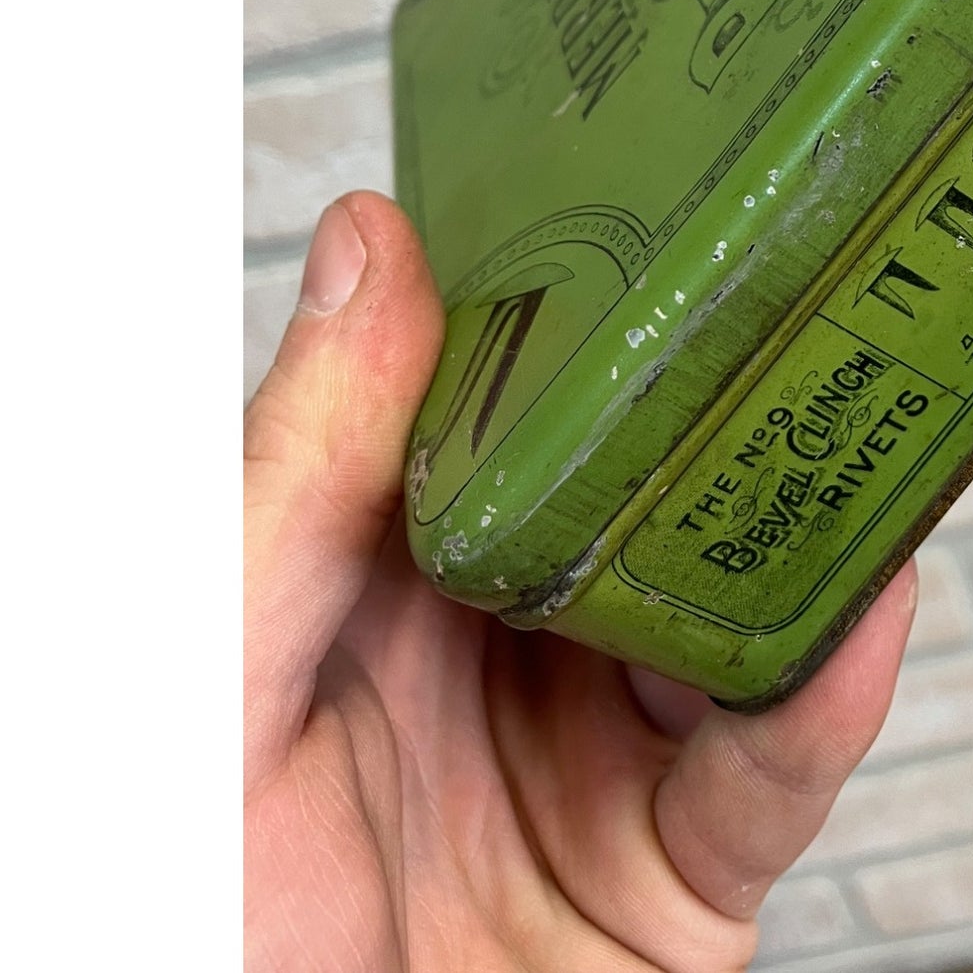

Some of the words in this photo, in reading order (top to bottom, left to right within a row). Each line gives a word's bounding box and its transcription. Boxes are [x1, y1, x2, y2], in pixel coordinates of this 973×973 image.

[675, 471, 743, 533] THE
[700, 463, 817, 575] BEVEL
[785, 347, 898, 462] CLINCH
[816, 388, 930, 512] RIVETS
